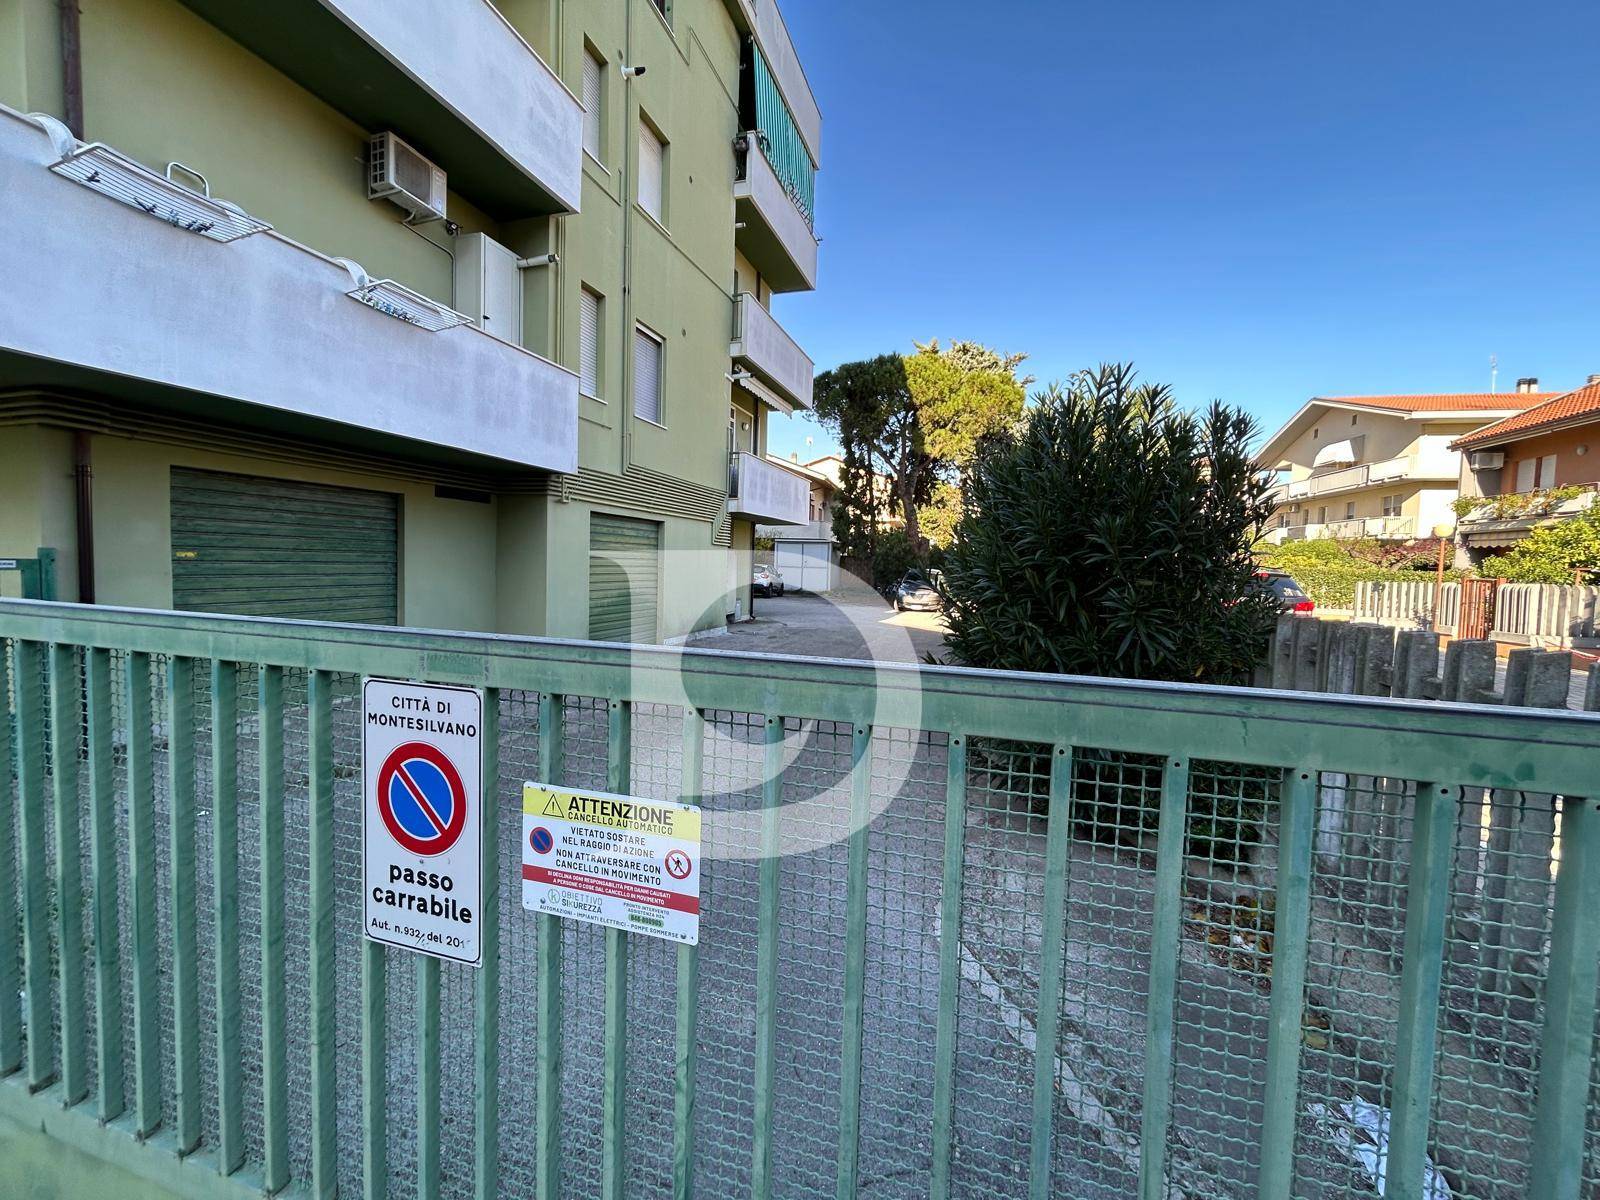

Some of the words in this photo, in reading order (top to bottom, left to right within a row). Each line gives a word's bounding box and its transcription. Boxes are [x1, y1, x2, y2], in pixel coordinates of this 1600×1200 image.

[392, 695, 430, 712] CITTÀ
[437, 701, 451, 715] DI
[368, 713, 476, 737] MONTESILVANO
[568, 796, 673, 826] ATTENZIONE
[568, 812, 612, 826] CANCELLO
[617, 819, 672, 835] AUTOMATICO
[562, 836, 578, 845] NEL
[581, 839, 610, 851] RAGGIO
[613, 844, 621, 852] DI
[623, 846, 654, 858] AZIONE
[571, 826, 604, 839] VIETATO
[607, 832, 646, 845] SOSTARE
[556, 860, 599, 874] CANCELLO
[612, 870, 661, 886] MOVIMENTO
[557, 849, 573, 858] NON
[575, 852, 641, 871] ATTRAVERSARE
[644, 864, 661, 875] CON
[390, 864, 453, 892] passo
[584, 878, 623, 889] RESPONSABILITÀ
[650, 890, 670, 898] CAUSATI
[373, 886, 472, 924] carrabile
[562, 890, 602, 905] OBIETTIVO
[562, 899, 602, 913] SIKUREZZA
[606, 888, 630, 897] CANCELLO
[637, 894, 664, 905] MOVIMENTO
[540, 905, 572, 915] AUTOMAZIONI
[577, 913, 599, 921] IMPIANTI
[600, 917, 626, 927] ELETTRICI
[650, 928, 678, 938] SOMMERSE
[642, 906, 669, 914] INTERVENTO
[372, 918, 391, 930] Aut.
[427, 932, 442, 943] del
